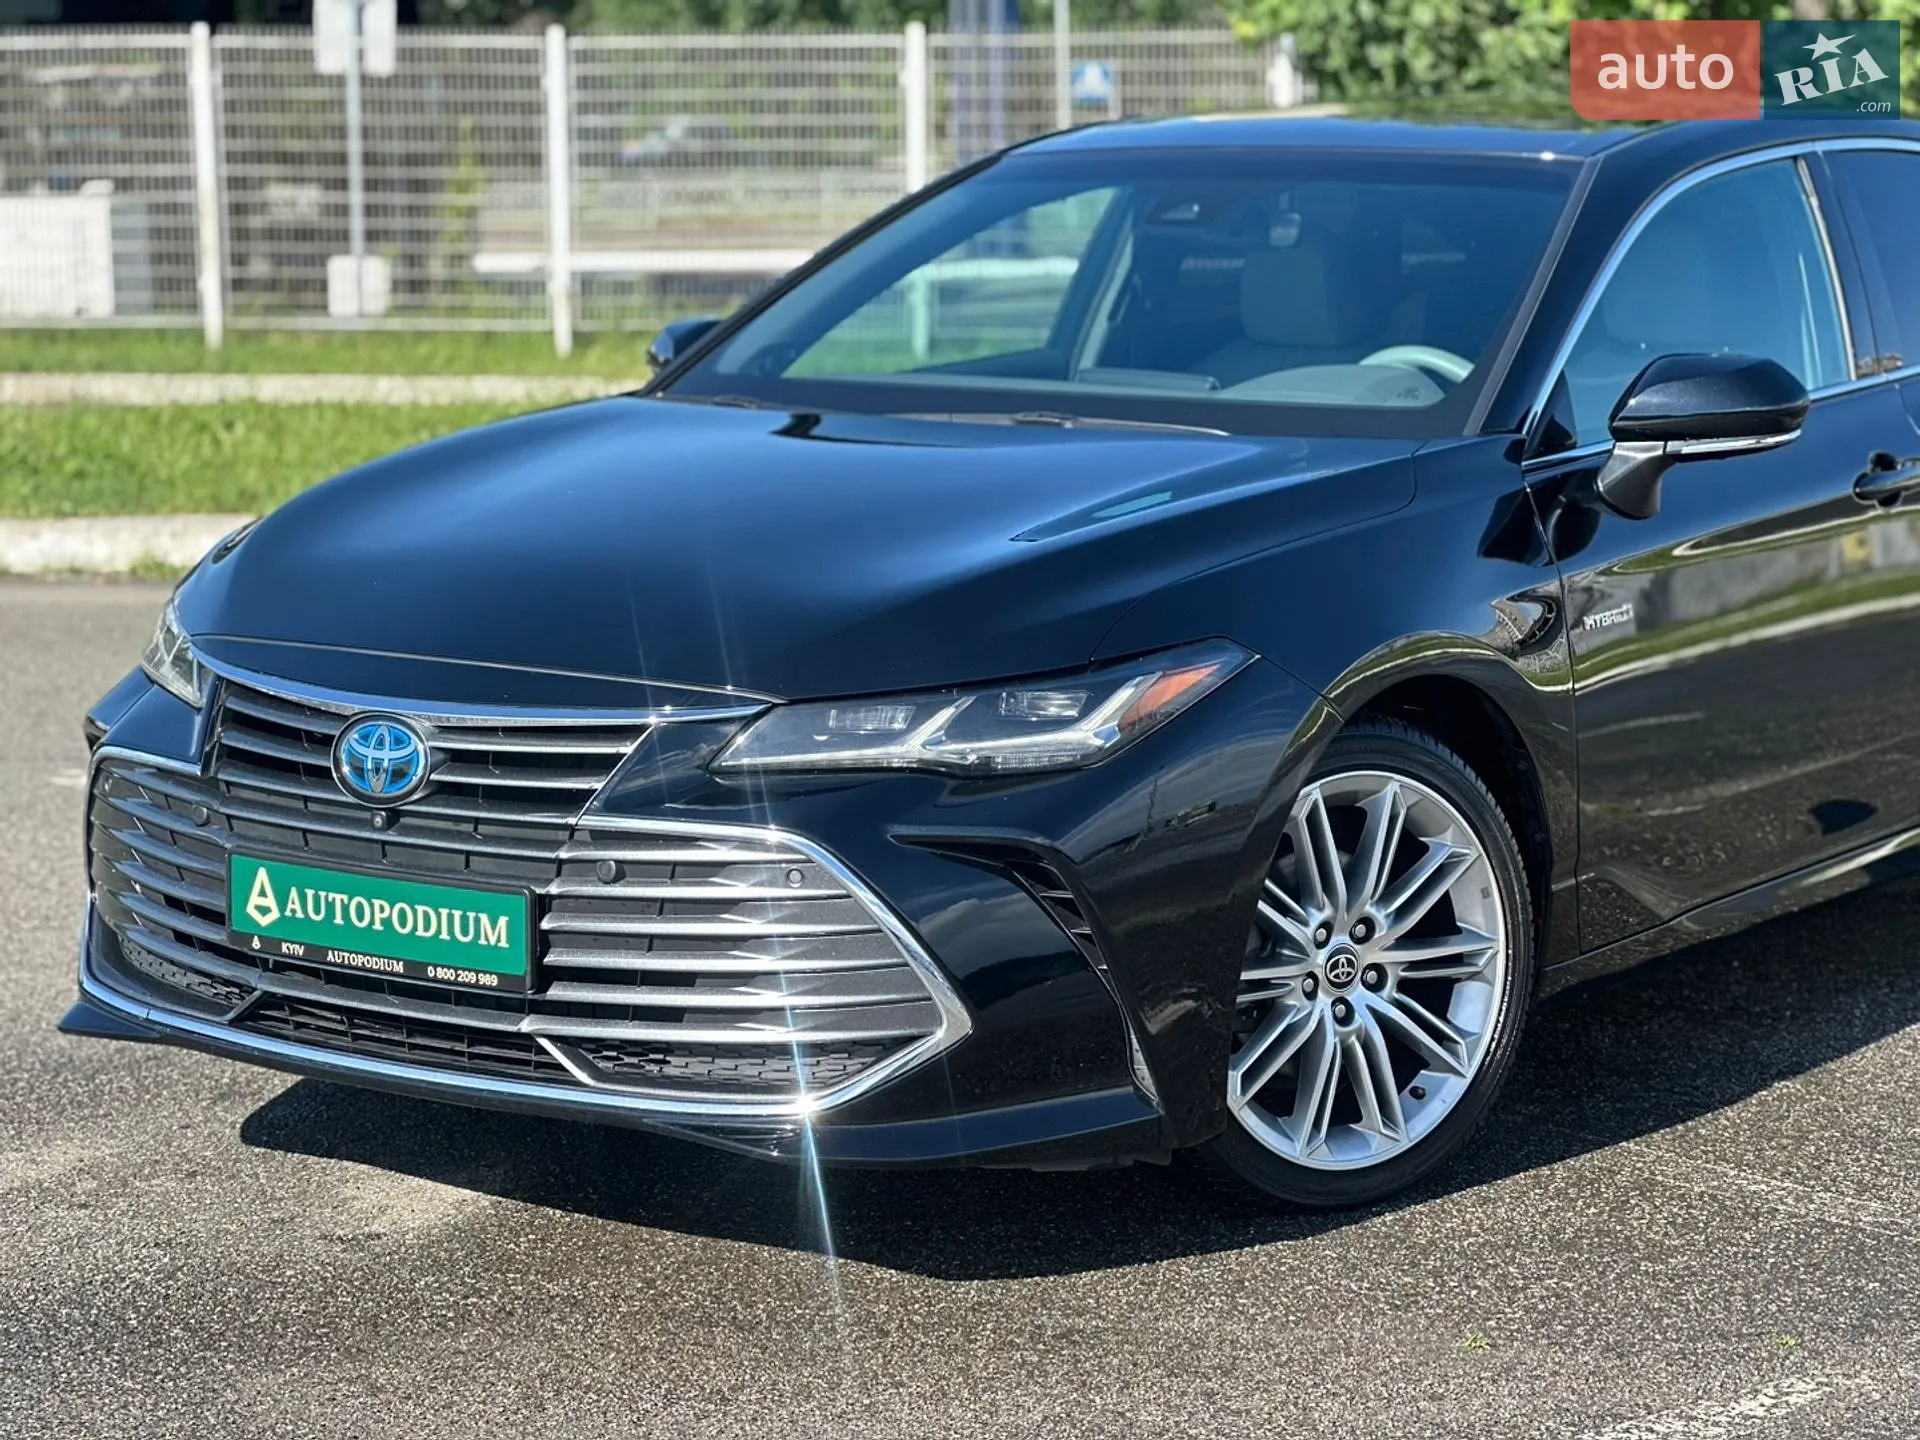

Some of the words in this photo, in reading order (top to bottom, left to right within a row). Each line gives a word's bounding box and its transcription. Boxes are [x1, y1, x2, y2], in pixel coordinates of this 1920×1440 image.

[284, 886, 510, 948] AUTOPODIUM
[281, 941, 305, 956] KYIV
[326, 950, 404, 973] AUTOPODIUM
[427, 966, 434, 978] 0
[436, 967, 456, 981] 800
[457, 970, 478, 984] 209
[478, 973, 498, 987] 989
